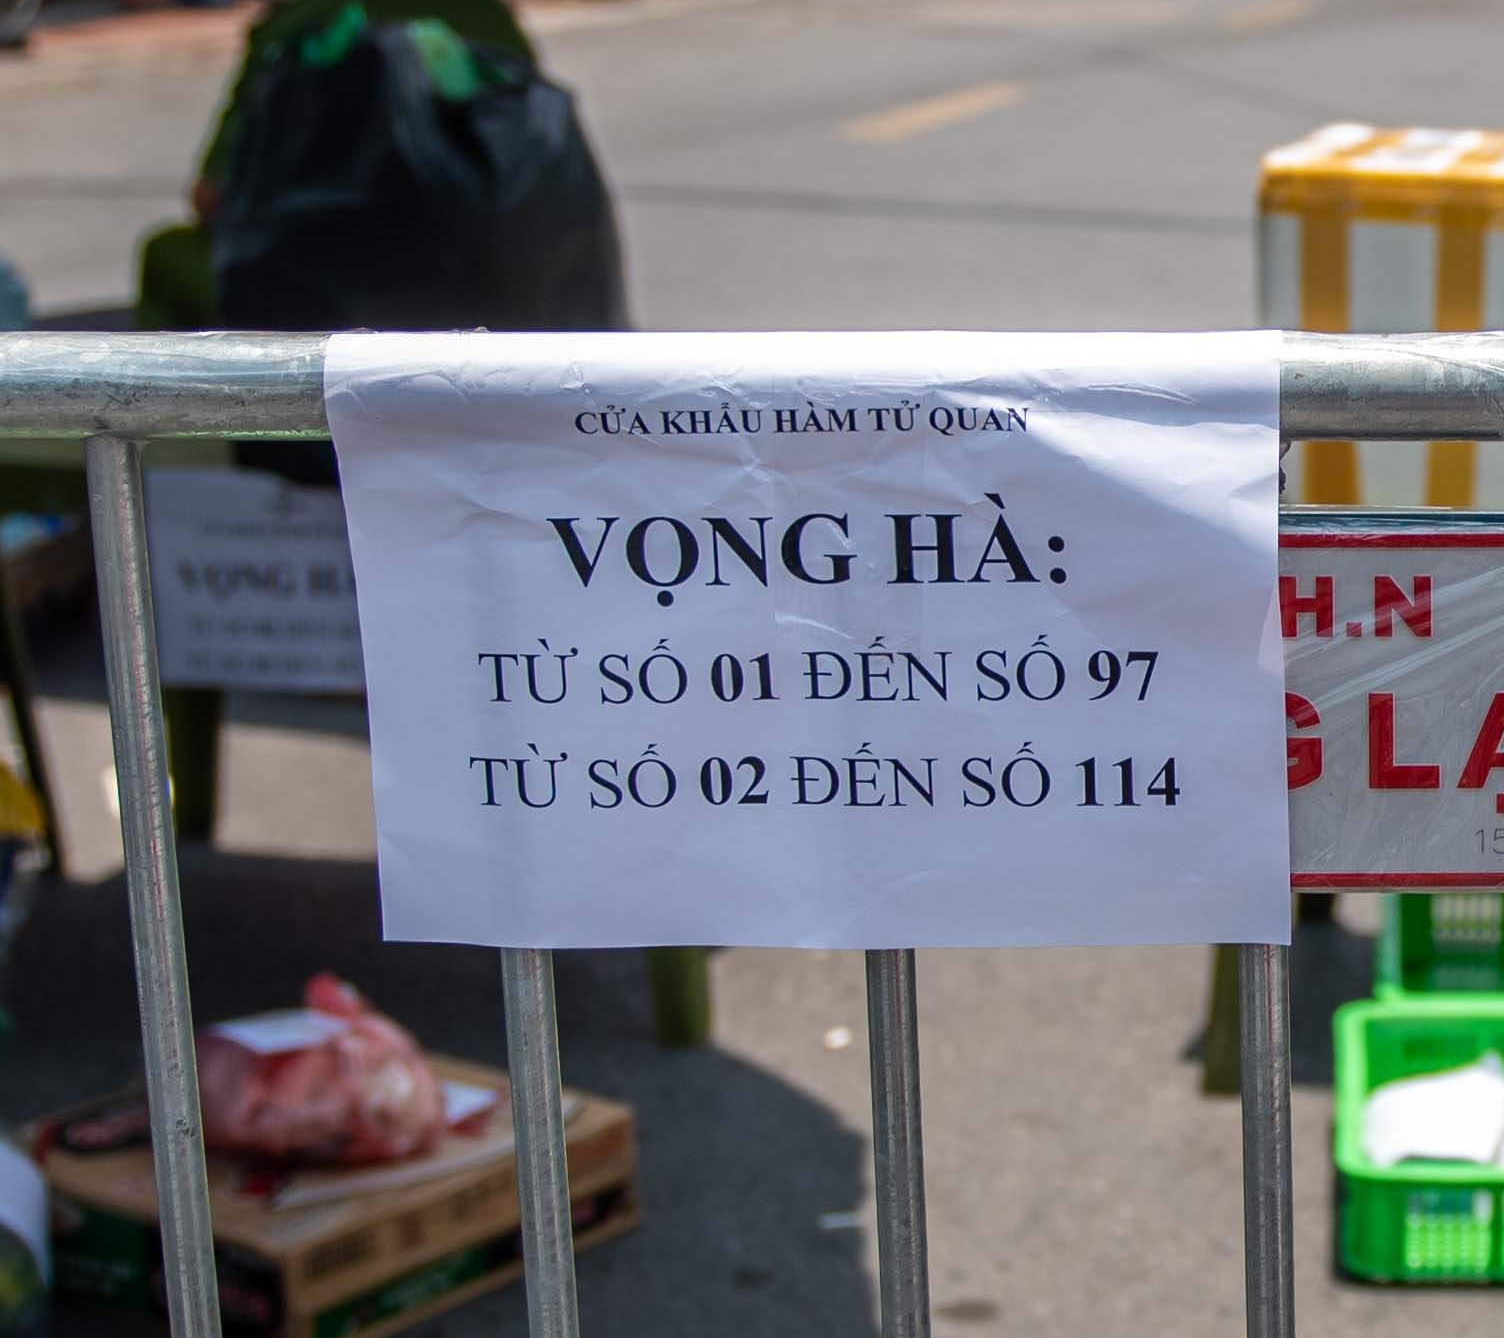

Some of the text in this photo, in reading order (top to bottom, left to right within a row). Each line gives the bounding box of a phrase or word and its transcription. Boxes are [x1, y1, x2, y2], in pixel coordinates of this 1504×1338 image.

[575, 404, 651, 435] CỬA
[772, 400, 859, 433] HÀM
[867, 400, 920, 431] TỬ
[928, 406, 1029, 437] QUAN
[546, 493, 1066, 607] VỌNG HÀ:
[478, 634, 1159, 705] TỪ SỐ 01 ĐẾN SỐ 97
[470, 741, 1180, 809] TỪ SỐ 02 ĐẾN SỐ 114
